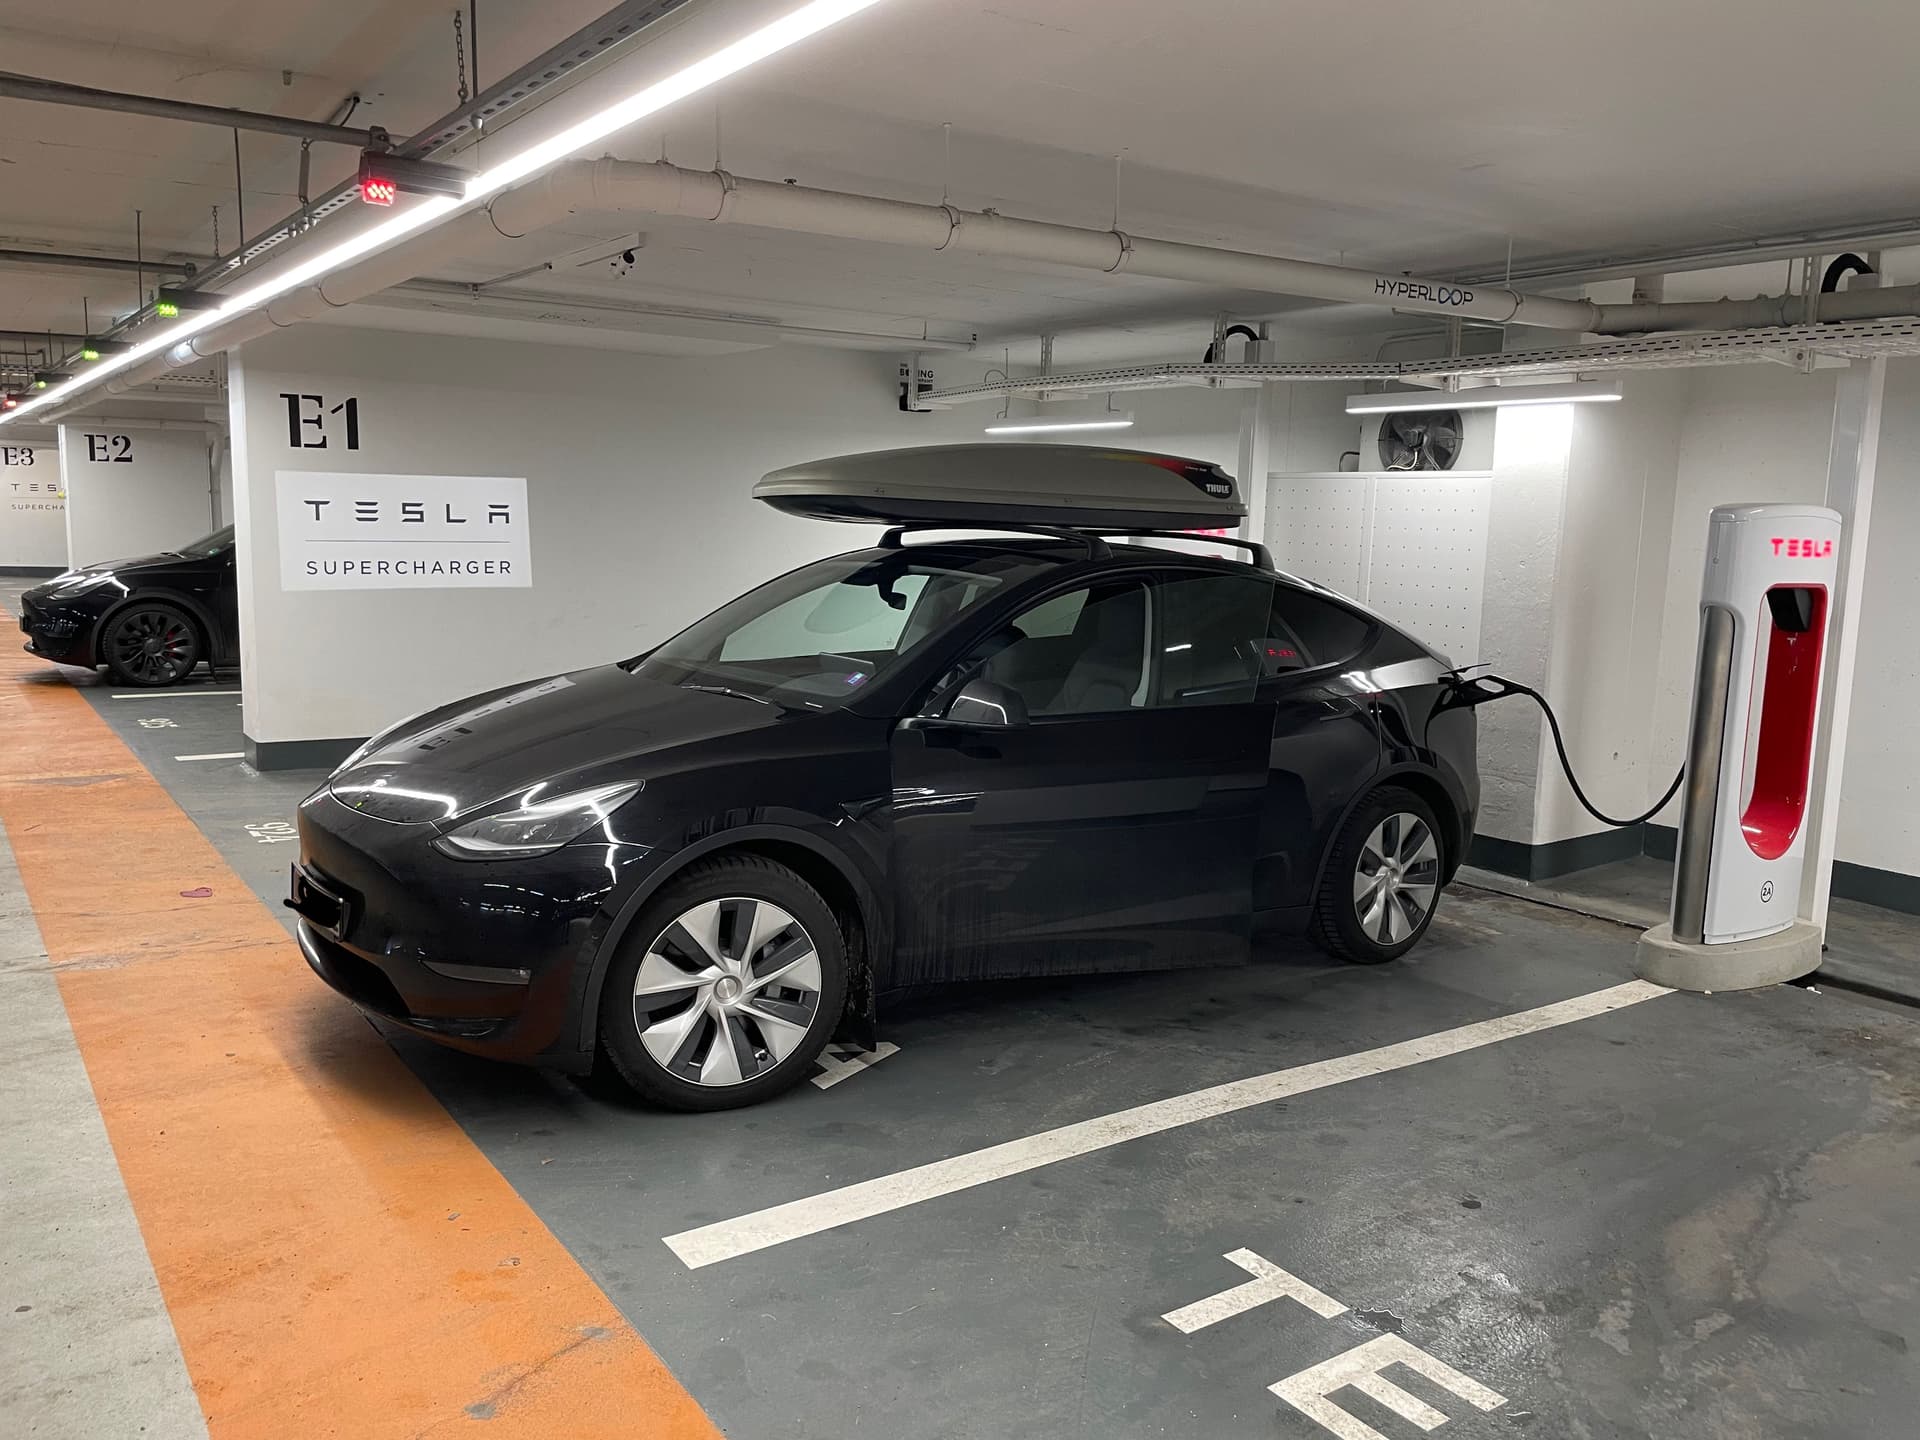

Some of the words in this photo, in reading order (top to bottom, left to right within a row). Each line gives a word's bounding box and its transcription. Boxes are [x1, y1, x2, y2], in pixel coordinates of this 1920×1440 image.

[1374, 278, 1473, 306] HYPERLOOP
[900, 368, 934, 379] BING
[280, 393, 359, 450] E1
[1, 446, 34, 466] E3
[84, 434, 133, 463] E2
[10, 483, 57, 492] TES
[1206, 483, 1230, 494] THULE
[11, 503, 65, 511] SUPERCHA
[304, 500, 510, 524] TESLA
[1771, 538, 1832, 557] TESLA
[306, 560, 512, 576] SUPERCHARGER
